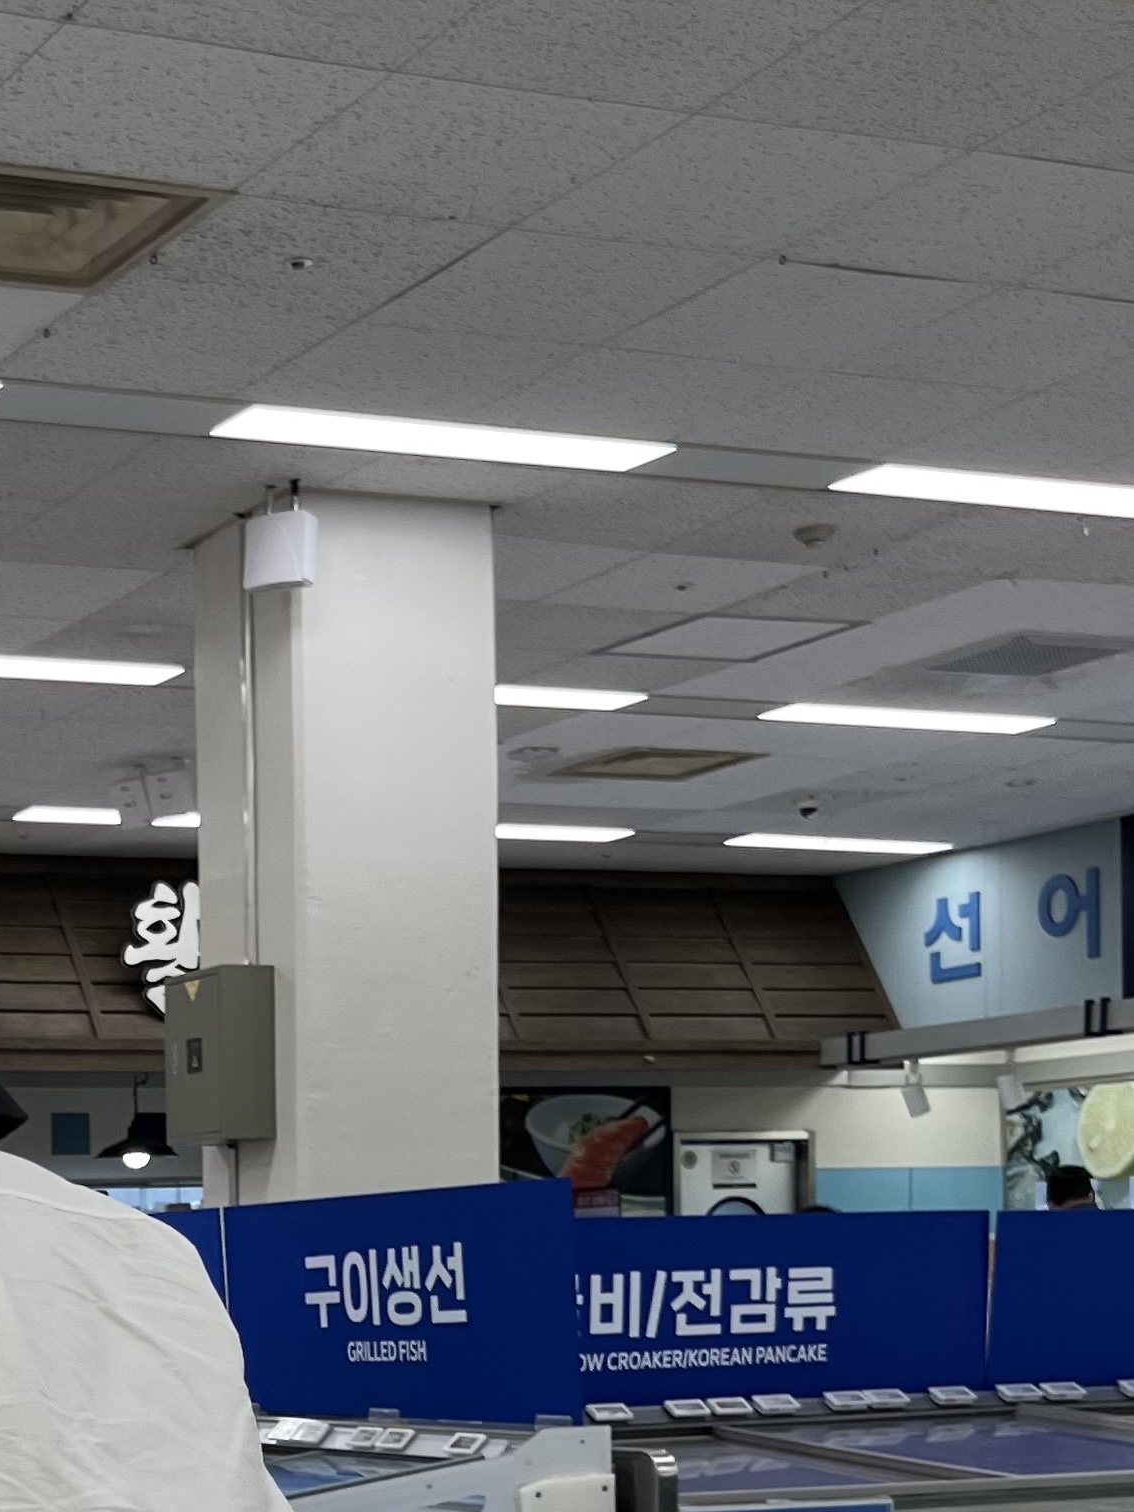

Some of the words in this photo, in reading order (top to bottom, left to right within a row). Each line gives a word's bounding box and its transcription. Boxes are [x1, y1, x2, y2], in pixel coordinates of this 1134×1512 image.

[304, 1241, 468, 1329] 구이생선
[574, 1266, 837, 1339] 비/전감류
[347, 1340, 397, 1362] GRILLED
[398, 1340, 428, 1362] FISH
[607, 1346, 753, 1371] CROAKER/KOREAN
[754, 1343, 829, 1364] PANCAKE
